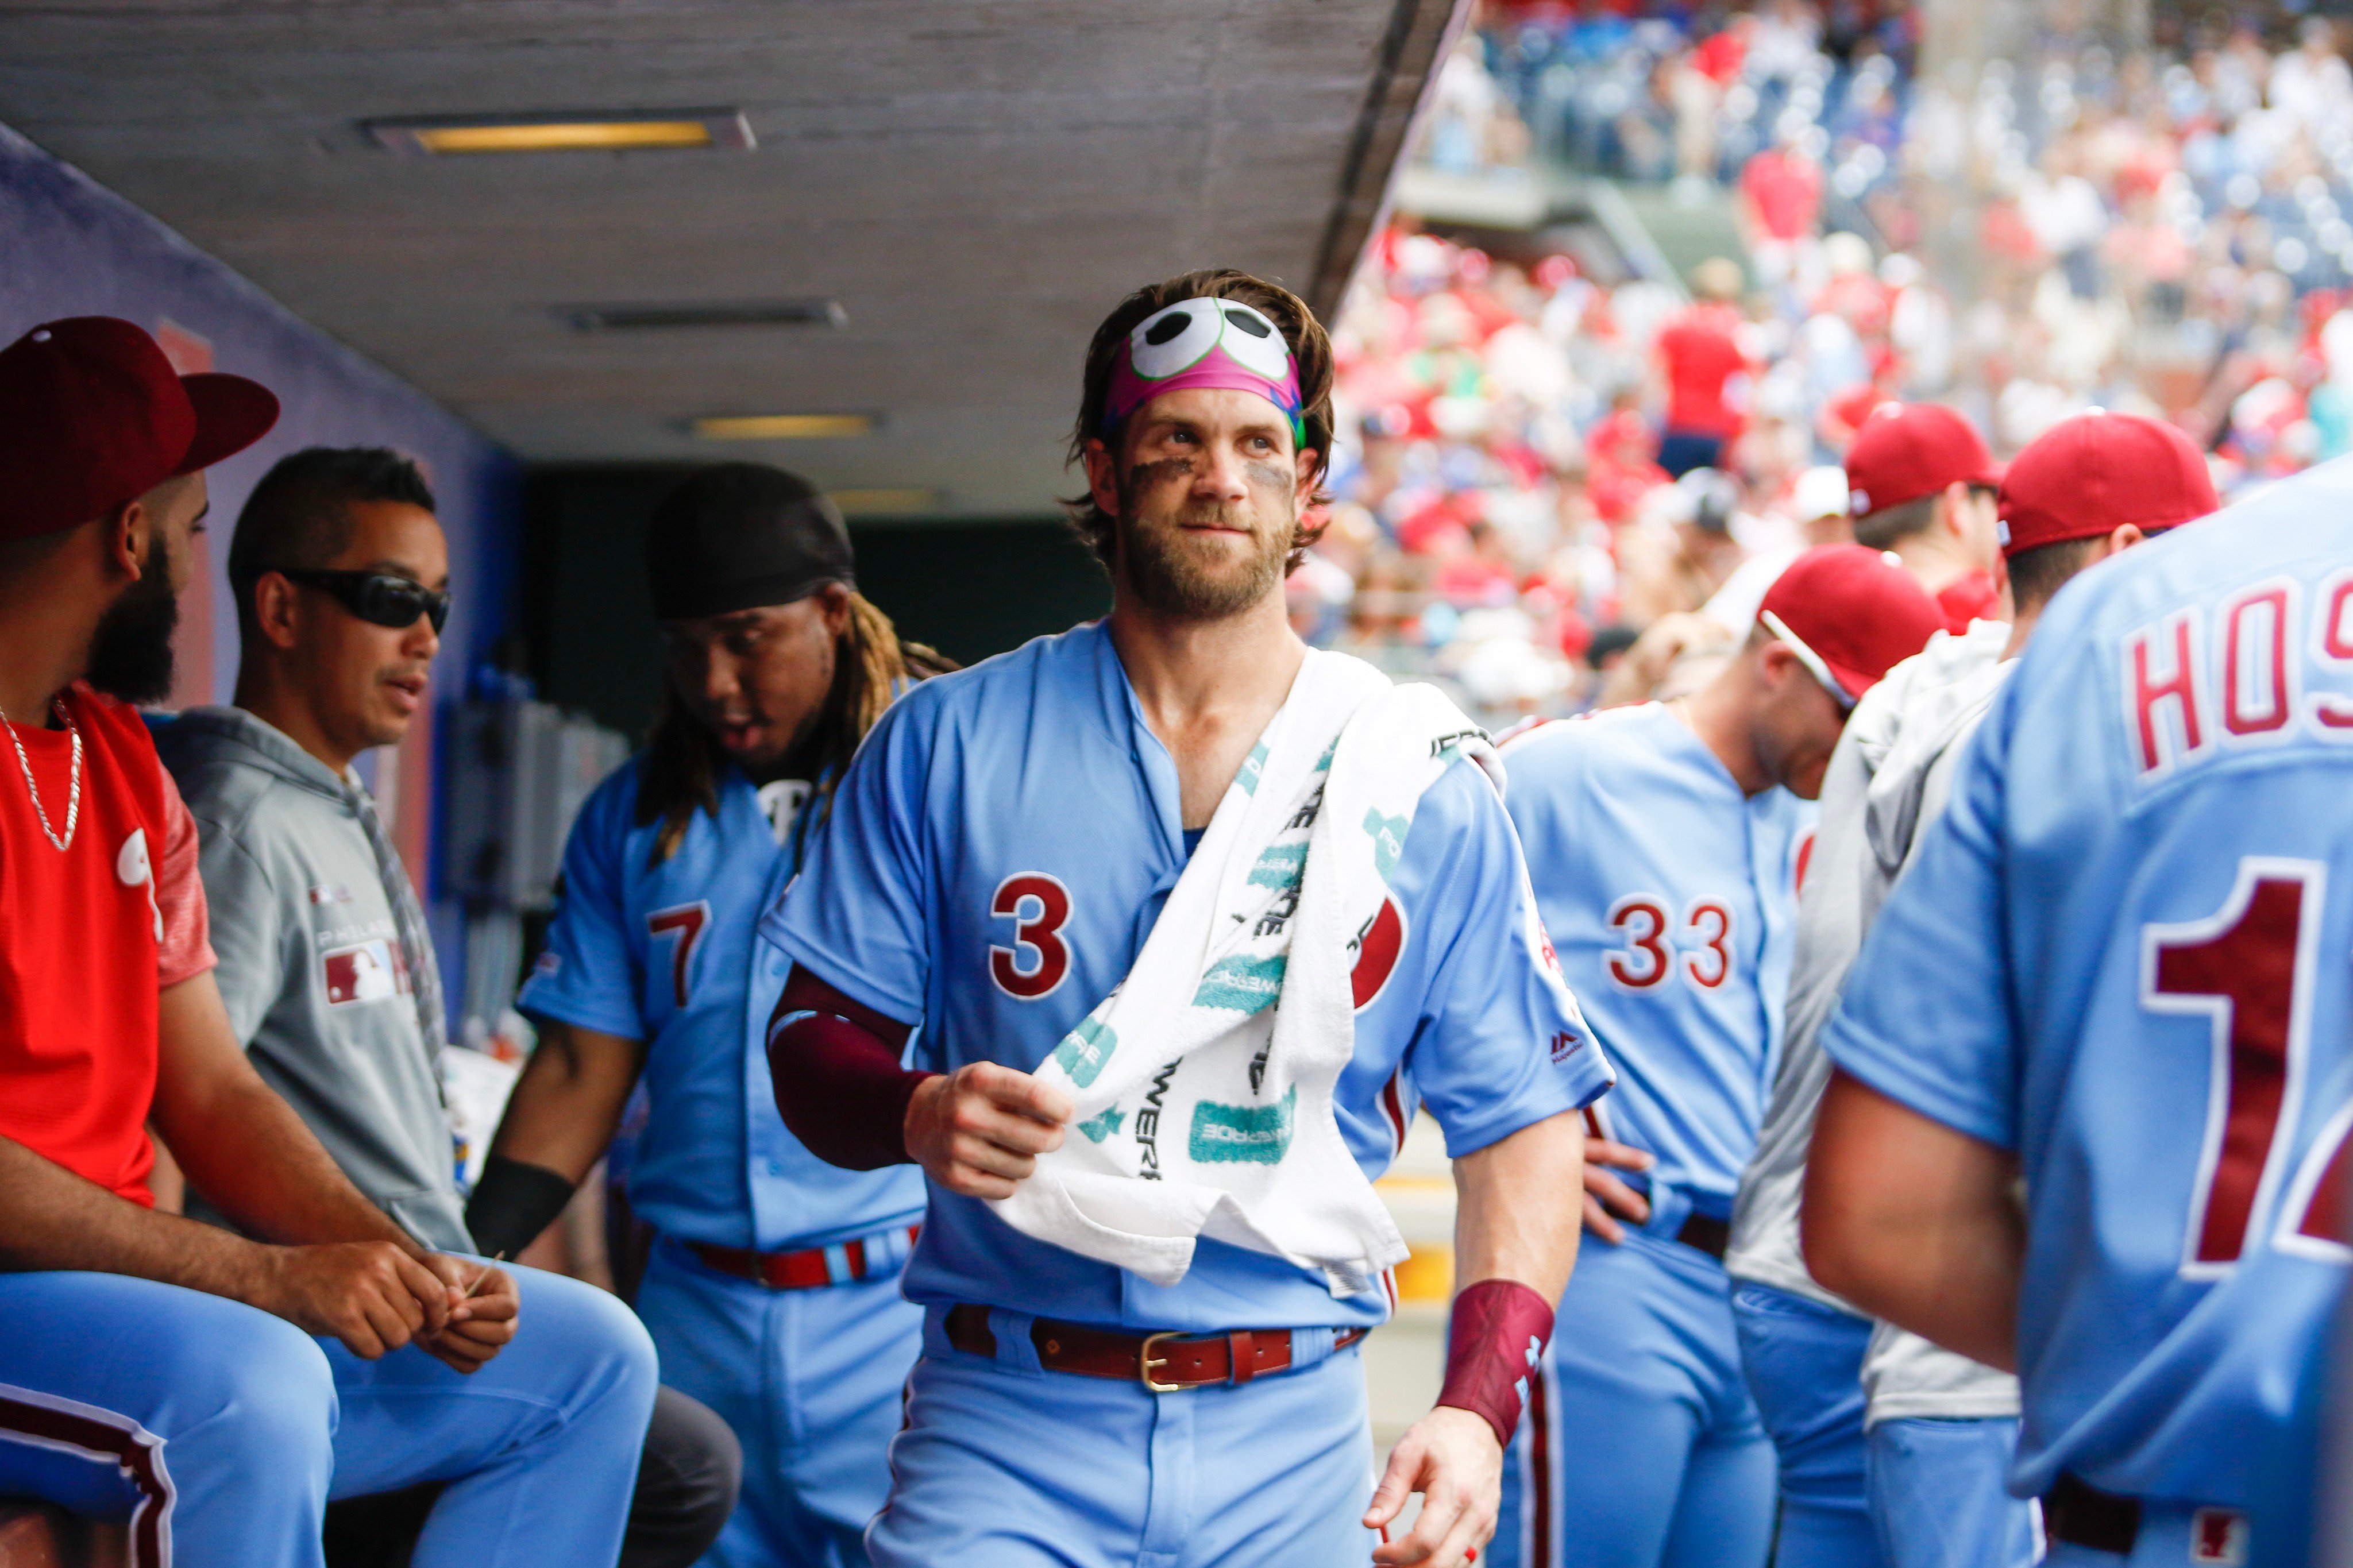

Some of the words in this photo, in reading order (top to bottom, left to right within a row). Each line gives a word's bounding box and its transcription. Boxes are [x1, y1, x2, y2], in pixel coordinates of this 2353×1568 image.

[645, 899, 713, 1011] 7
[989, 870, 1074, 1001] 3
[1602, 892, 1737, 997] 33
